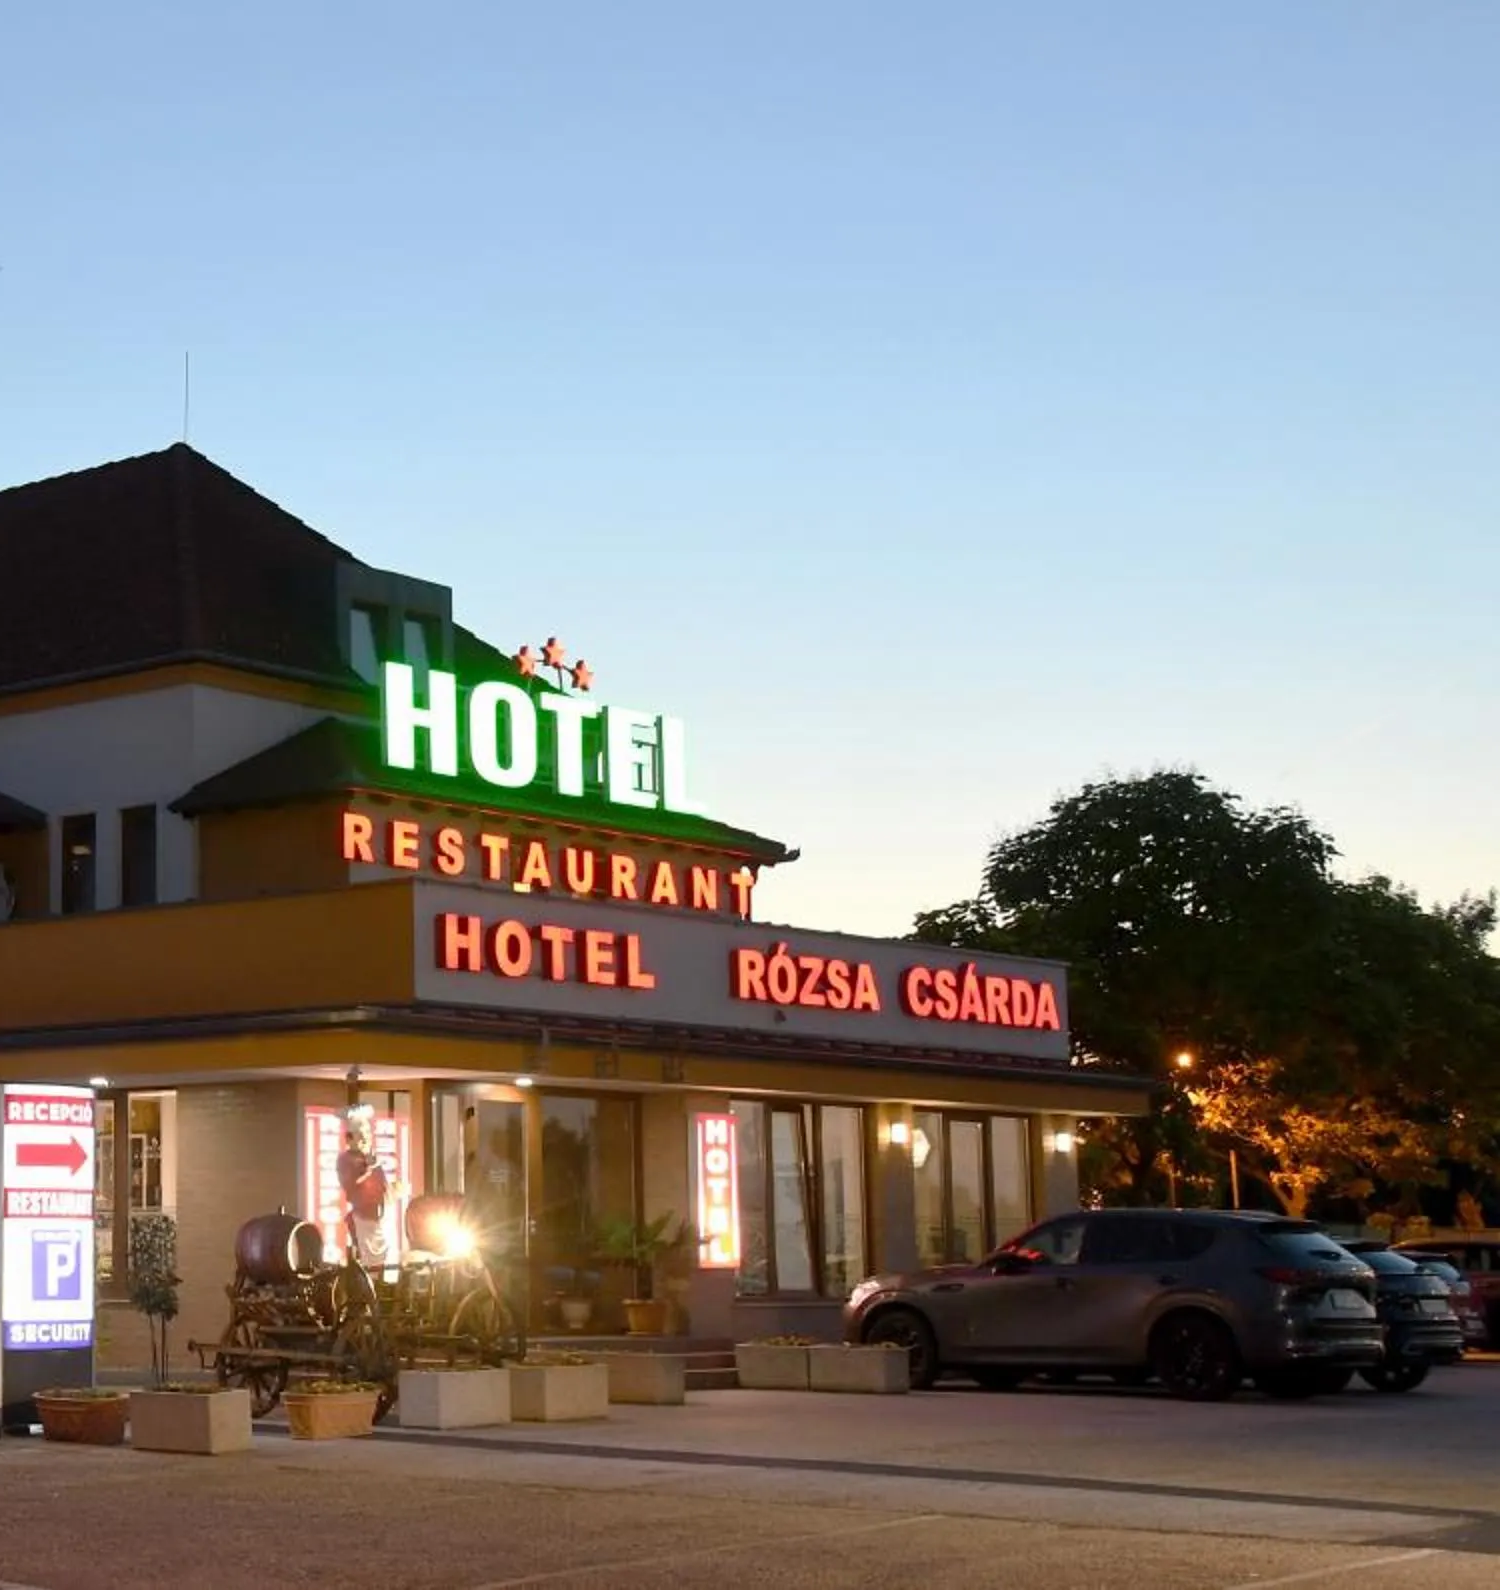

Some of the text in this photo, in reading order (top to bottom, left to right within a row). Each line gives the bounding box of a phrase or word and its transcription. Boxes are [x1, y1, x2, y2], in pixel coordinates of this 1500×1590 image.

[383, 661, 710, 820] HOTEL
[341, 811, 755, 919] RESTAURANT
[441, 912, 1060, 1031] HOTEL RÓZSA CSÁRDA
[7, 1101, 92, 1122] RECEPCIÓ
[10, 1323, 92, 1343] SECURITY
